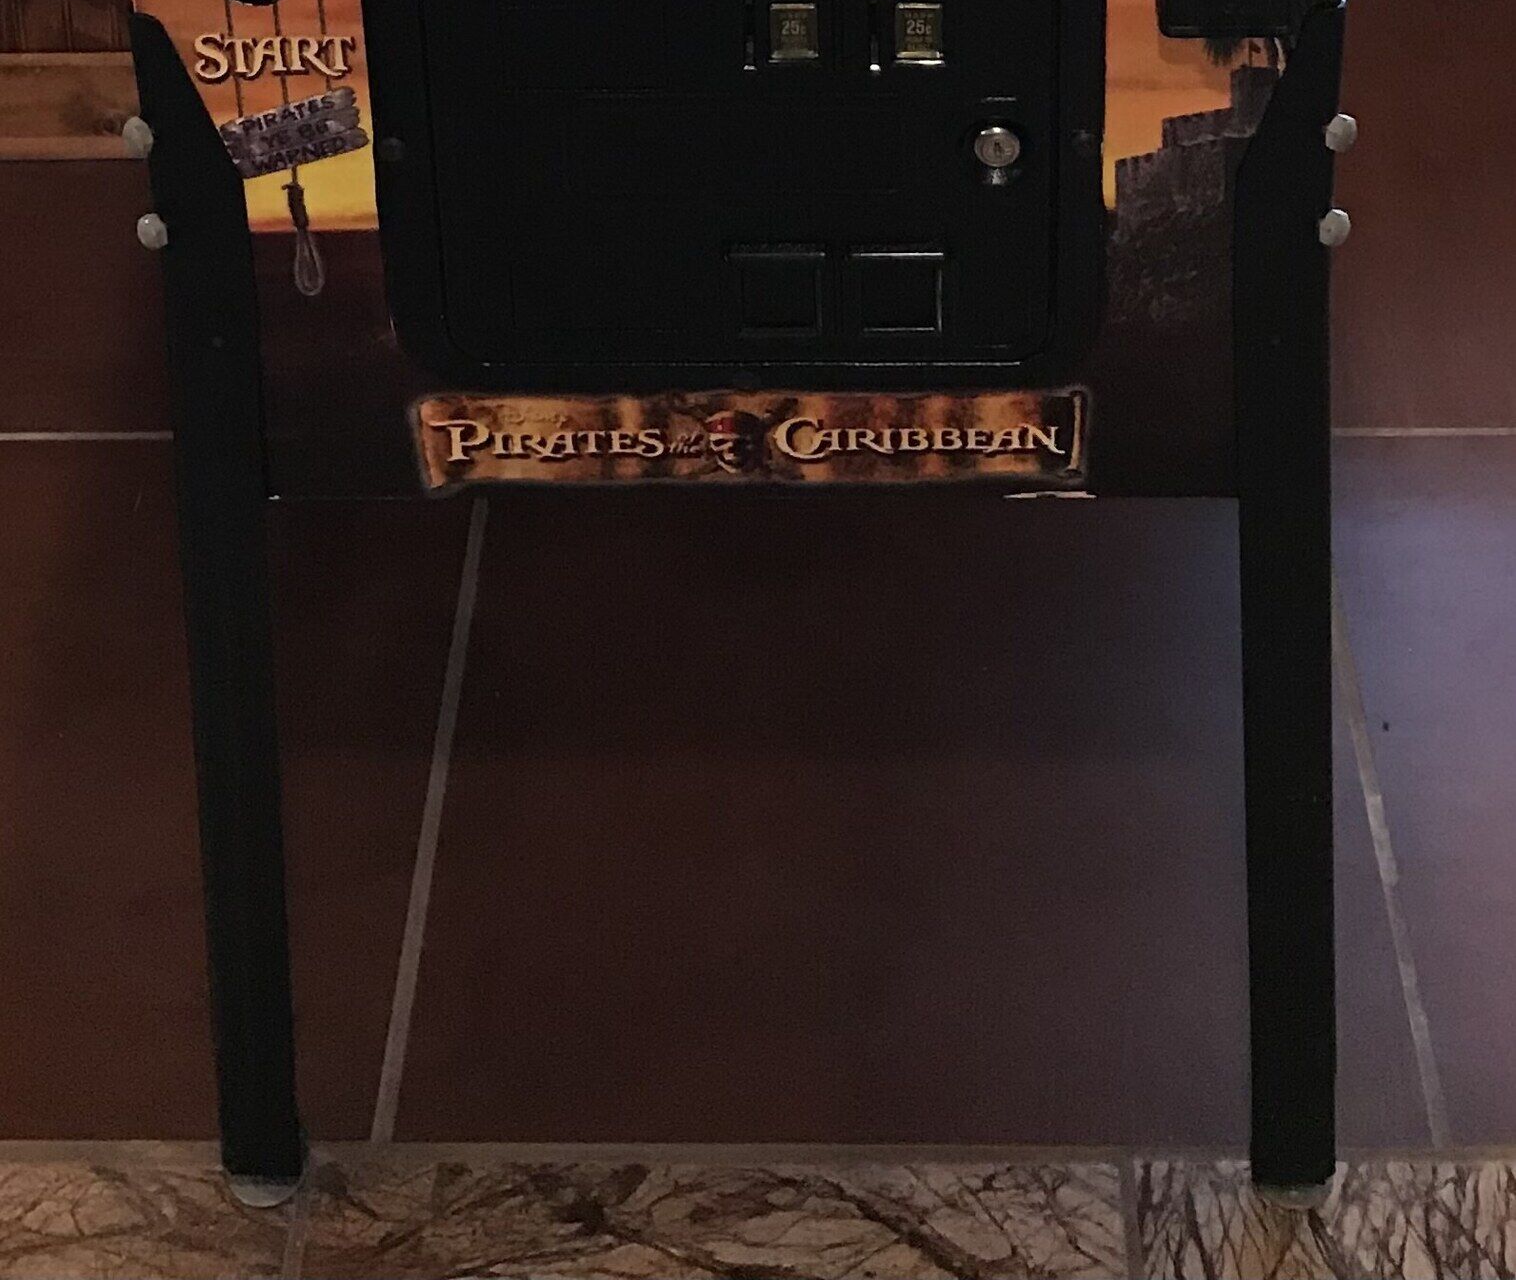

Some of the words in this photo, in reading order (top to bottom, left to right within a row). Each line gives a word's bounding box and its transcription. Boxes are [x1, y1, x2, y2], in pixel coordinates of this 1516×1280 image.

[194, 33, 355, 80] START
[238, 95, 335, 134] PIRATES
[428, 418, 665, 462] PIRATES
[772, 416, 1066, 460] CARIBBEAN
